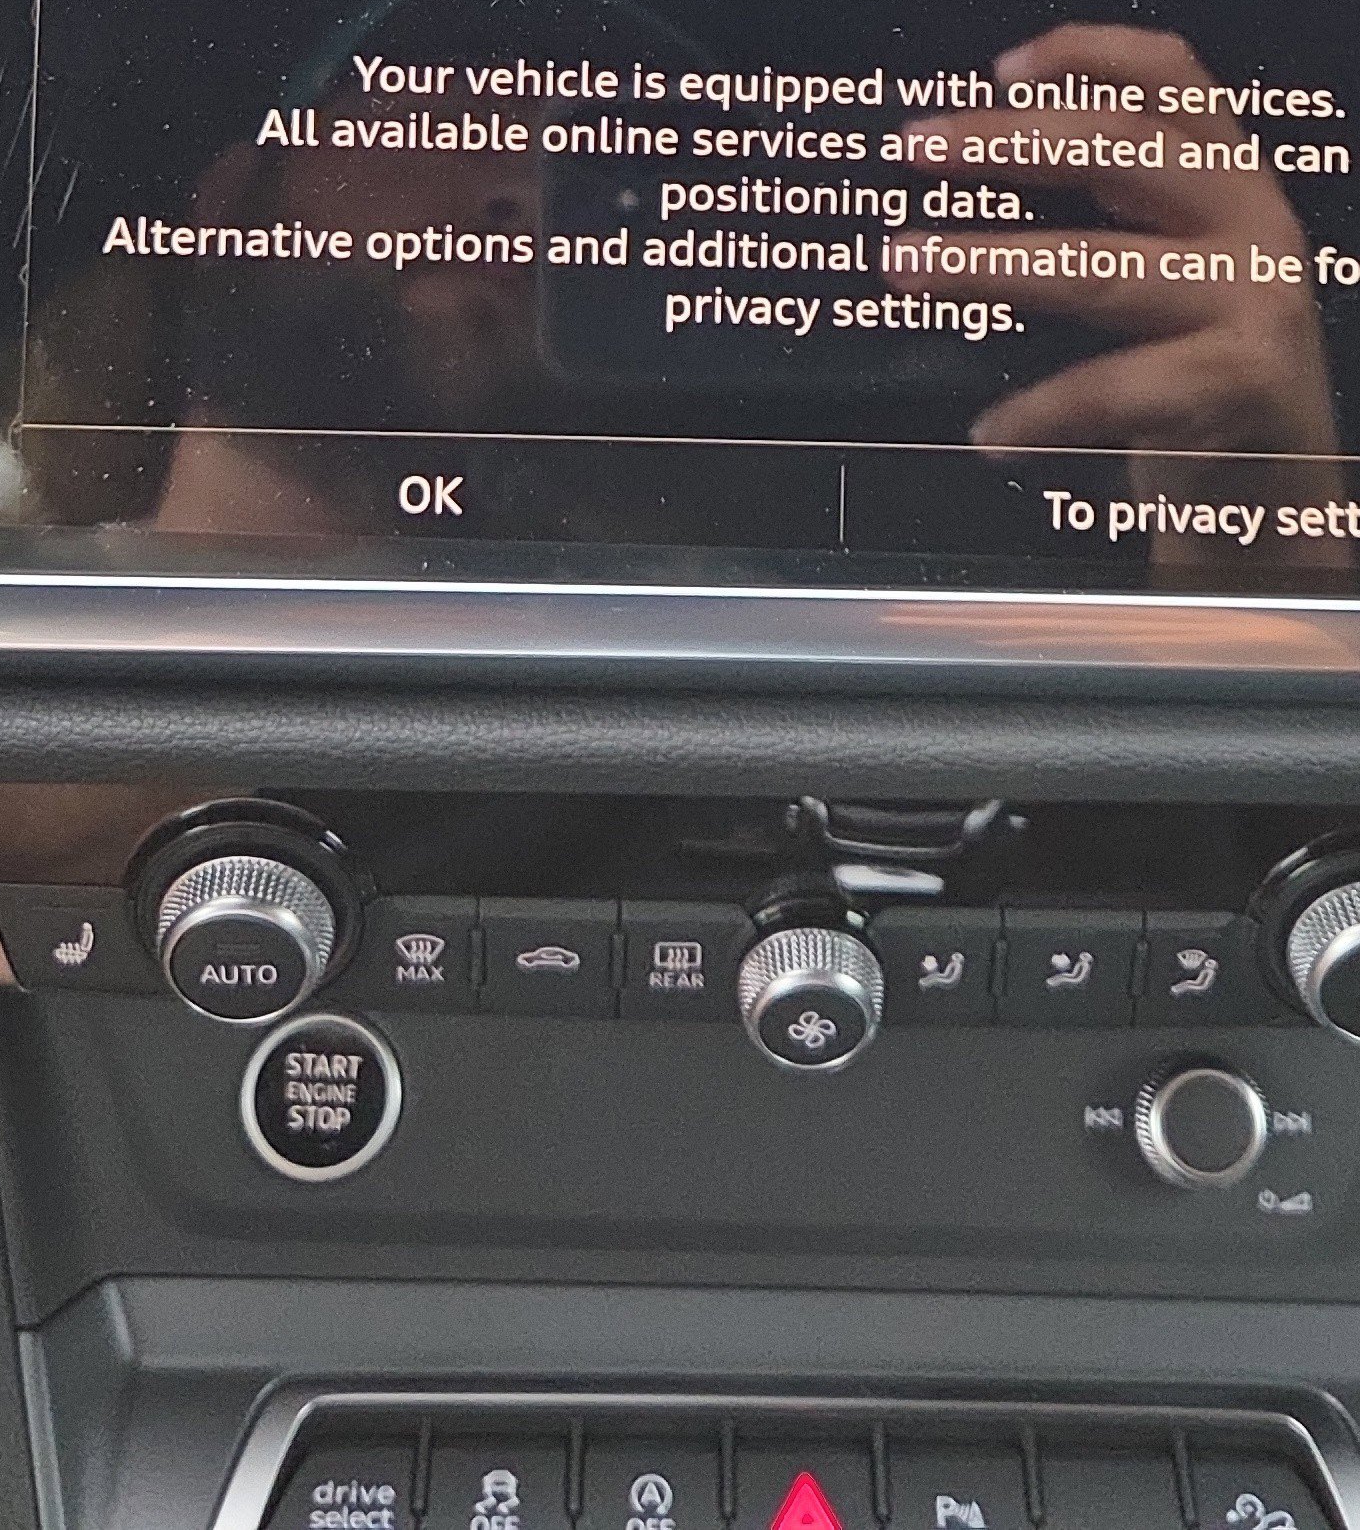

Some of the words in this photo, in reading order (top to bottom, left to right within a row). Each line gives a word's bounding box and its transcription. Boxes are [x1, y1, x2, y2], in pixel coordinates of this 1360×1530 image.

[352, 54, 456, 95] Your
[465, 57, 620, 99] vehicle
[632, 62, 667, 100] is
[679, 65, 884, 111] equipped
[896, 70, 994, 109] with
[1007, 72, 1145, 113] online
[1157, 78, 1346, 119] services.
[256, 107, 320, 148] All
[330, 110, 530, 152] available
[541, 115, 680, 156] online
[692, 121, 867, 161] services
[879, 133, 949, 163] are
[961, 127, 1165, 169] activated
[1178, 133, 1260, 172] and
[1273, 143, 1350, 174] can
[660, 178, 908, 227] positioning
[922, 179, 1034, 221] data.
[102, 215, 354, 260] Alternative
[365, 223, 535, 271] options
[546, 226, 629, 266] and
[642, 228, 869, 272] additional
[881, 234, 1146, 280] information
[1158, 251, 1236, 283] can
[1249, 243, 1304, 284] be
[665, 285, 821, 337] privacy
[832, 291, 1025, 342] settings.
[398, 474, 464, 516] OK
[1042, 489, 1096, 531] To
[1108, 493, 1266, 546] privacy
[200, 963, 278, 985] AUTO
[395, 964, 445, 983] MAX
[648, 970, 705, 989] REAR
[285, 1052, 363, 1079] START
[285, 1081, 357, 1104] ENGINE
[287, 1104, 351, 1131] STOP
[311, 1479, 397, 1507] drive
[308, 1504, 396, 1530] select
